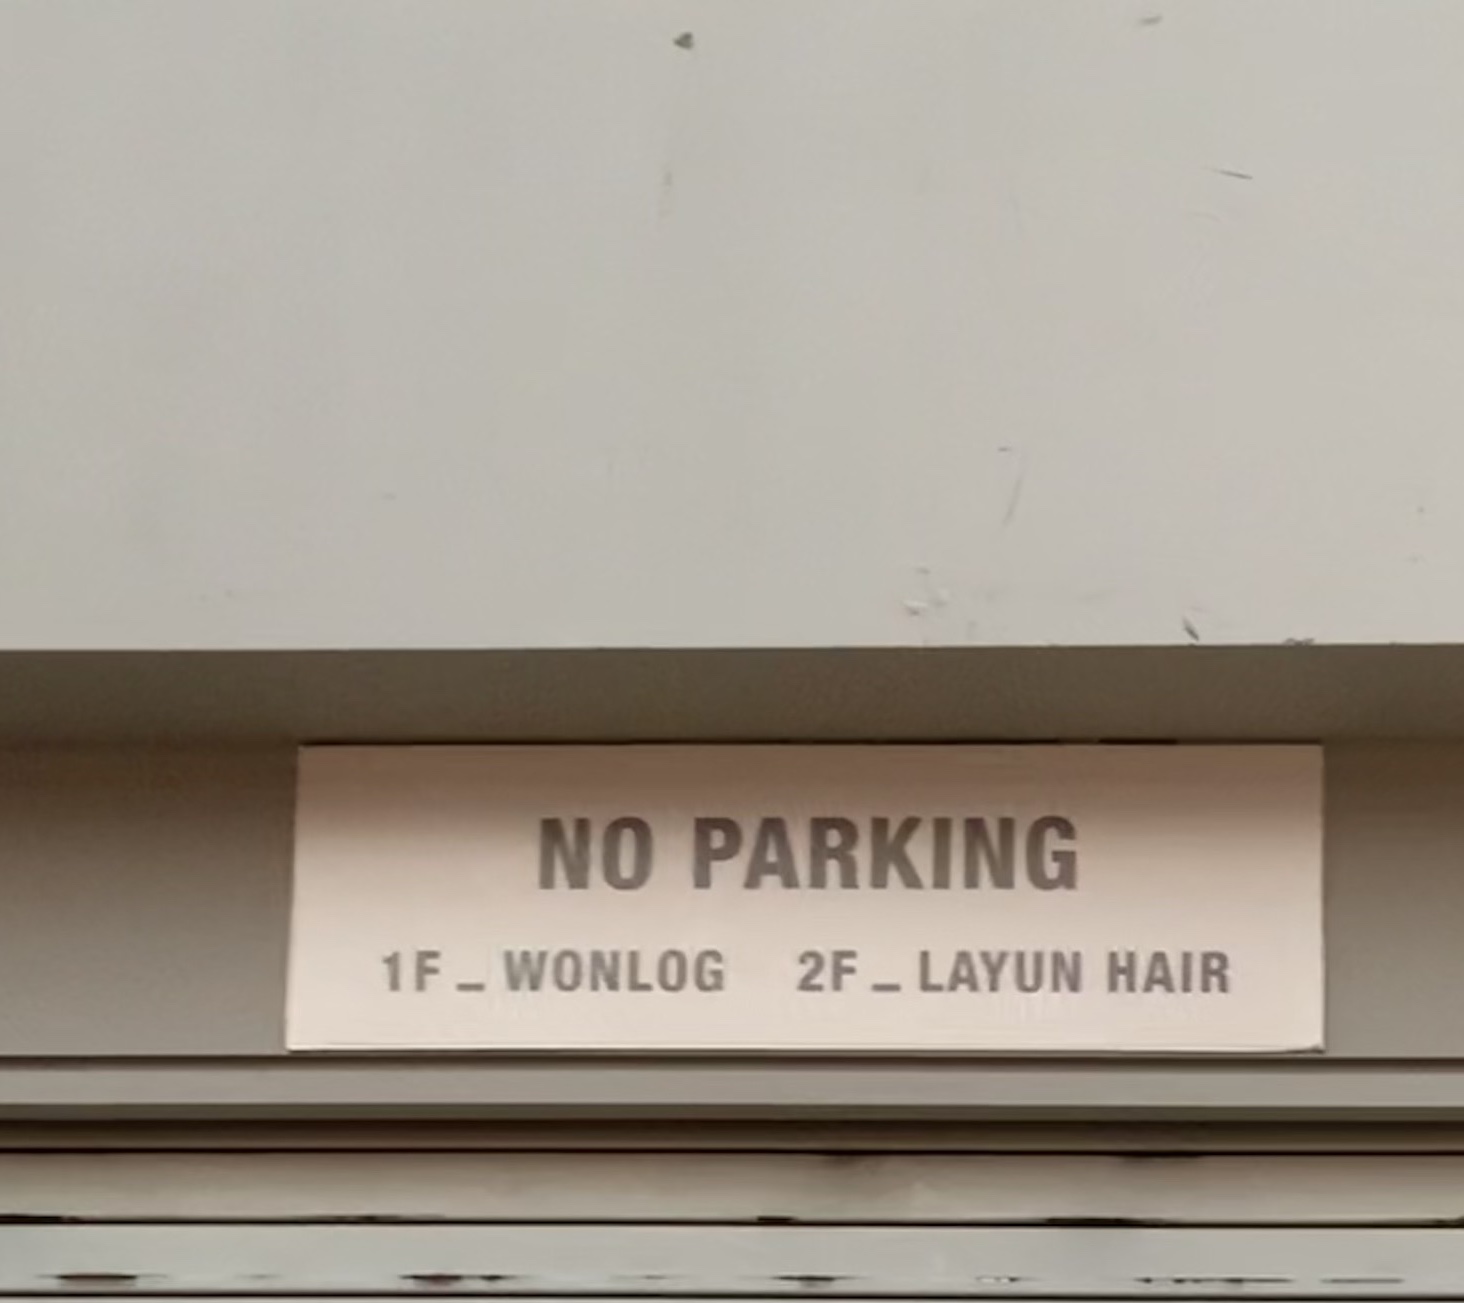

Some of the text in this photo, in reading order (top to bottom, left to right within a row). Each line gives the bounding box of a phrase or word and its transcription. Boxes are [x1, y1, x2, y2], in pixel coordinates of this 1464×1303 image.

[537, 814, 1078, 891] NO PARKING
[1105, 949, 1231, 994] HAIR
